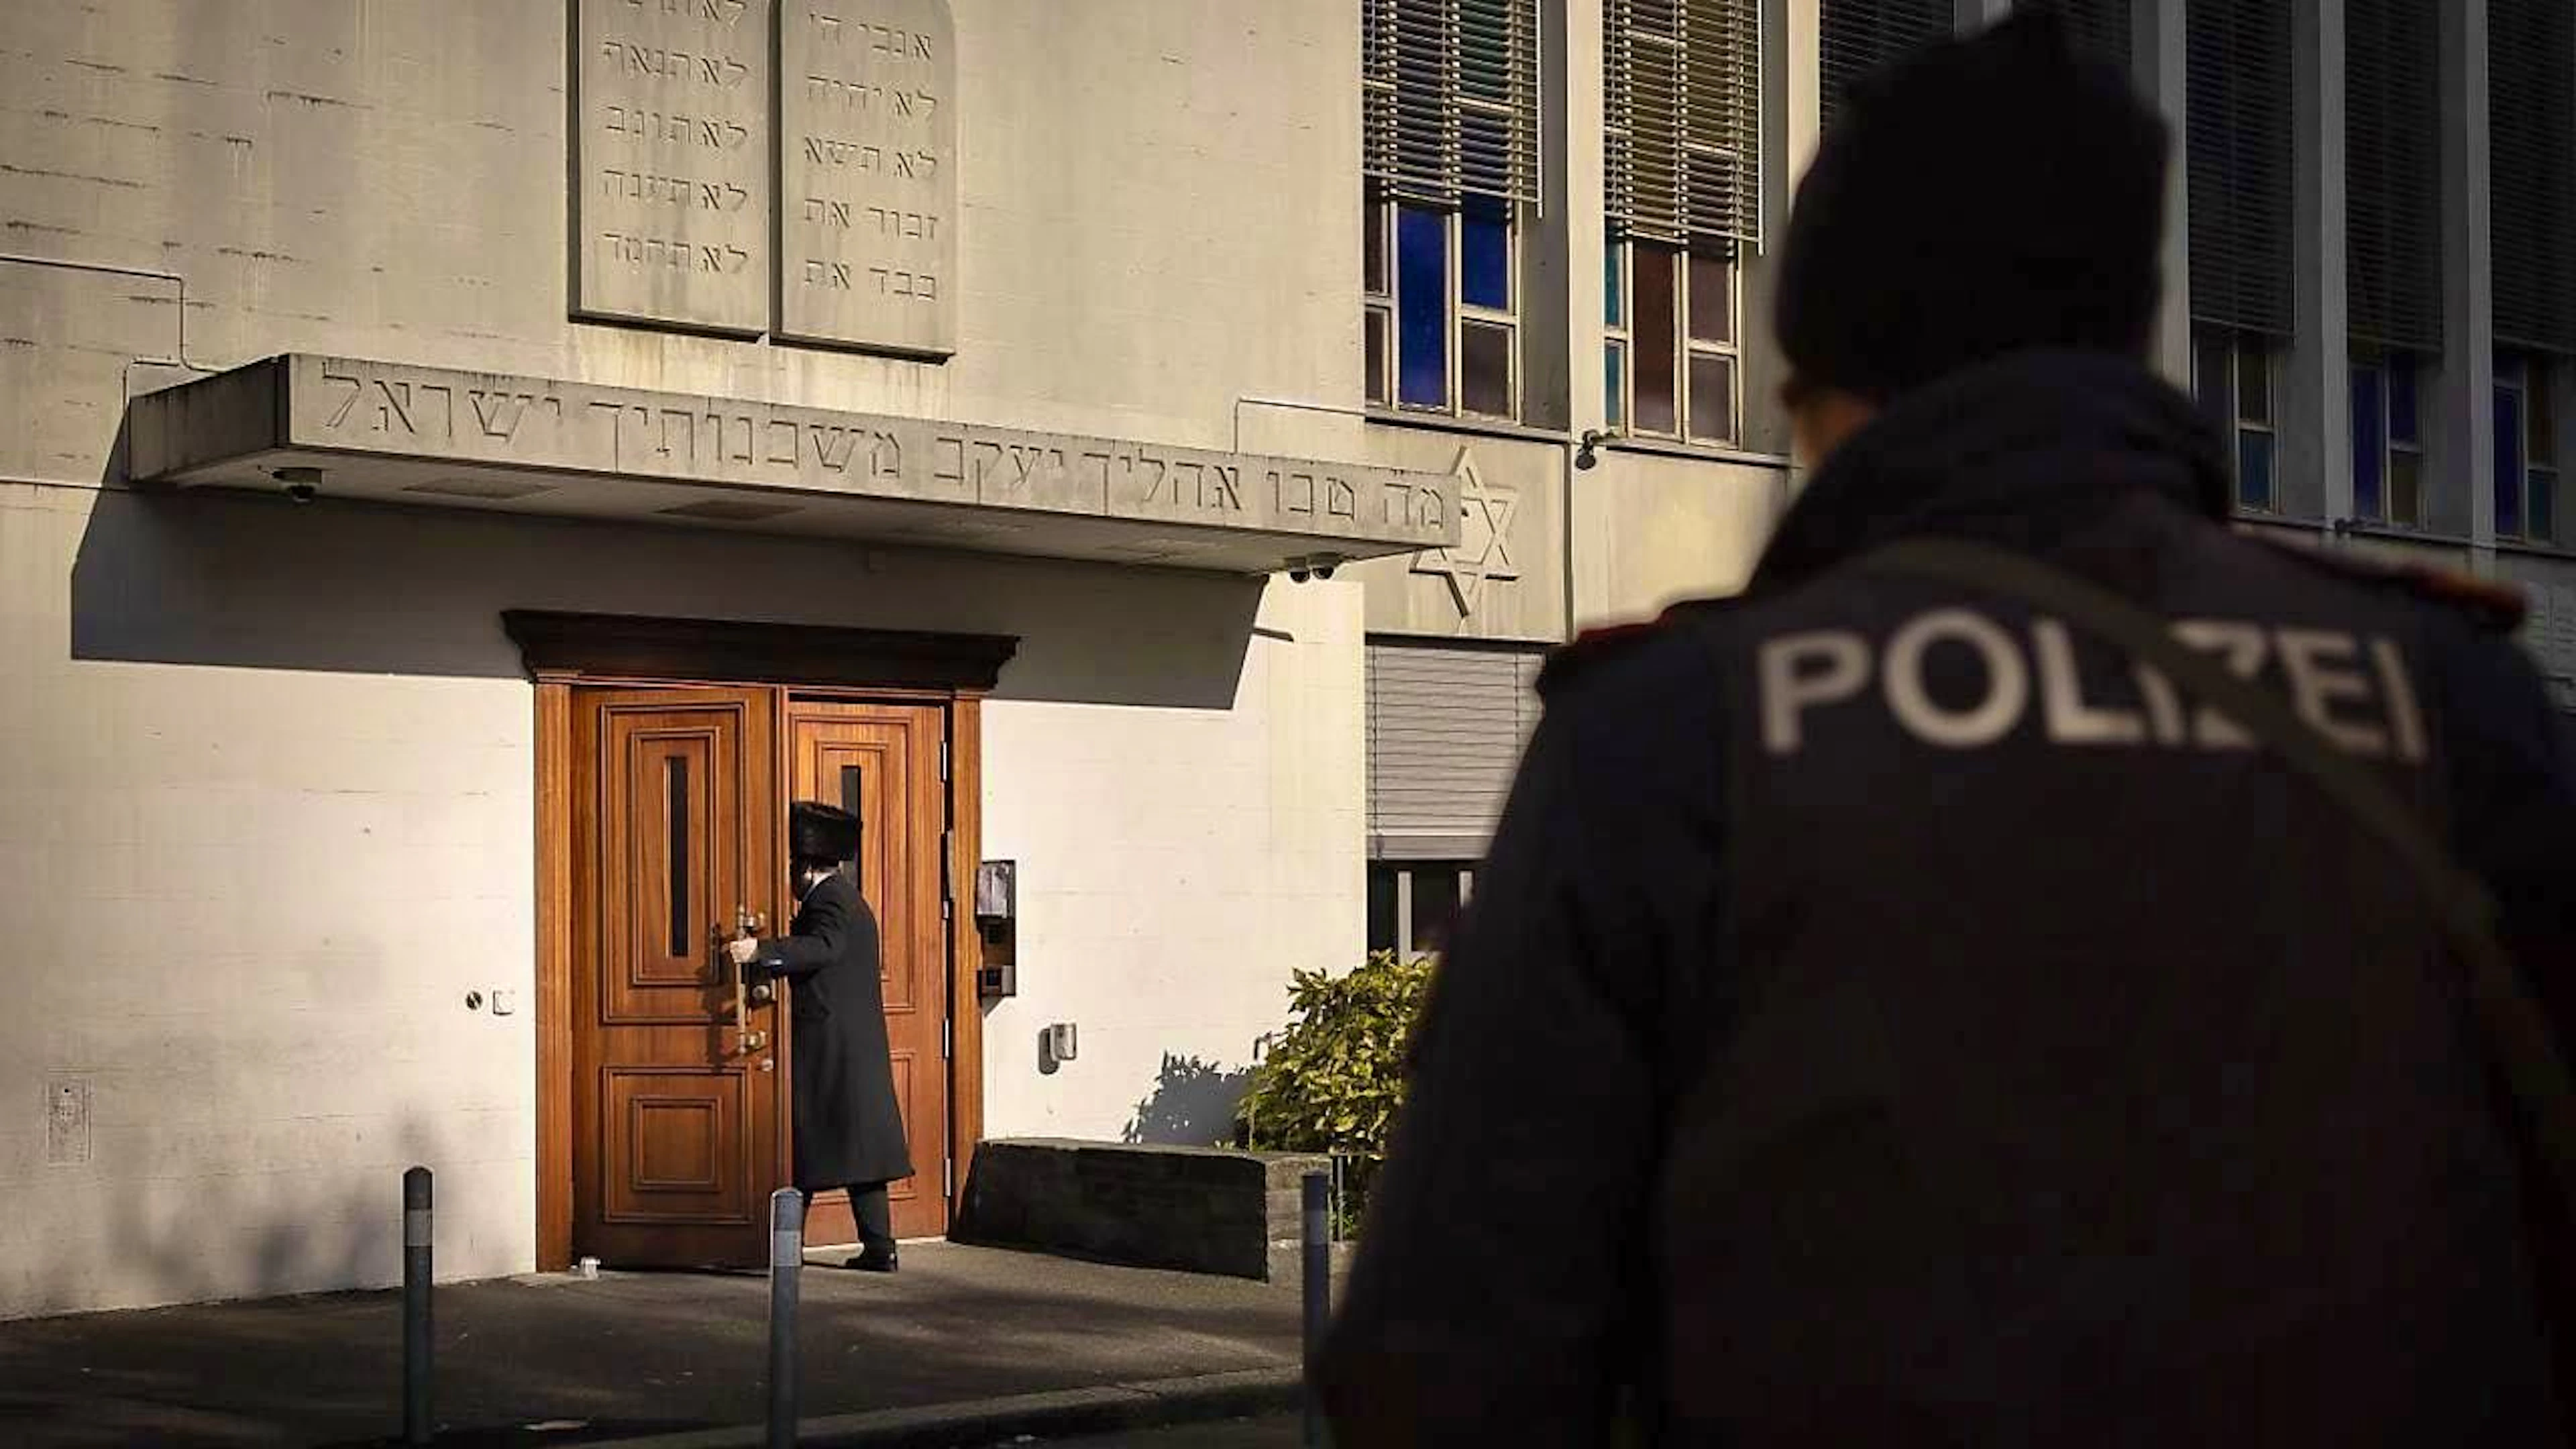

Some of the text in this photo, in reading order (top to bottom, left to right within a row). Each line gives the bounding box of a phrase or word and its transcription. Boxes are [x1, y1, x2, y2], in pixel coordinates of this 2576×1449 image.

[701, 56, 747, 87] לא
[806, 74, 937, 121] לא יהיה
[699, 121, 748, 149] לא
[895, 152, 937, 178] לא
[702, 182, 748, 212] לא
[804, 198, 938, 240] זכור את
[702, 244, 748, 273] לא
[804, 259, 936, 301] כבד את
[321, 360, 561, 440] ישראל
[933, 436, 1063, 506] יעקב
[1082, 449, 1242, 517] אהליך
[1267, 470, 1355, 522] טבו
[1383, 482, 1444, 529] מה
[1758, 608, 2427, 763] POLIZEI
